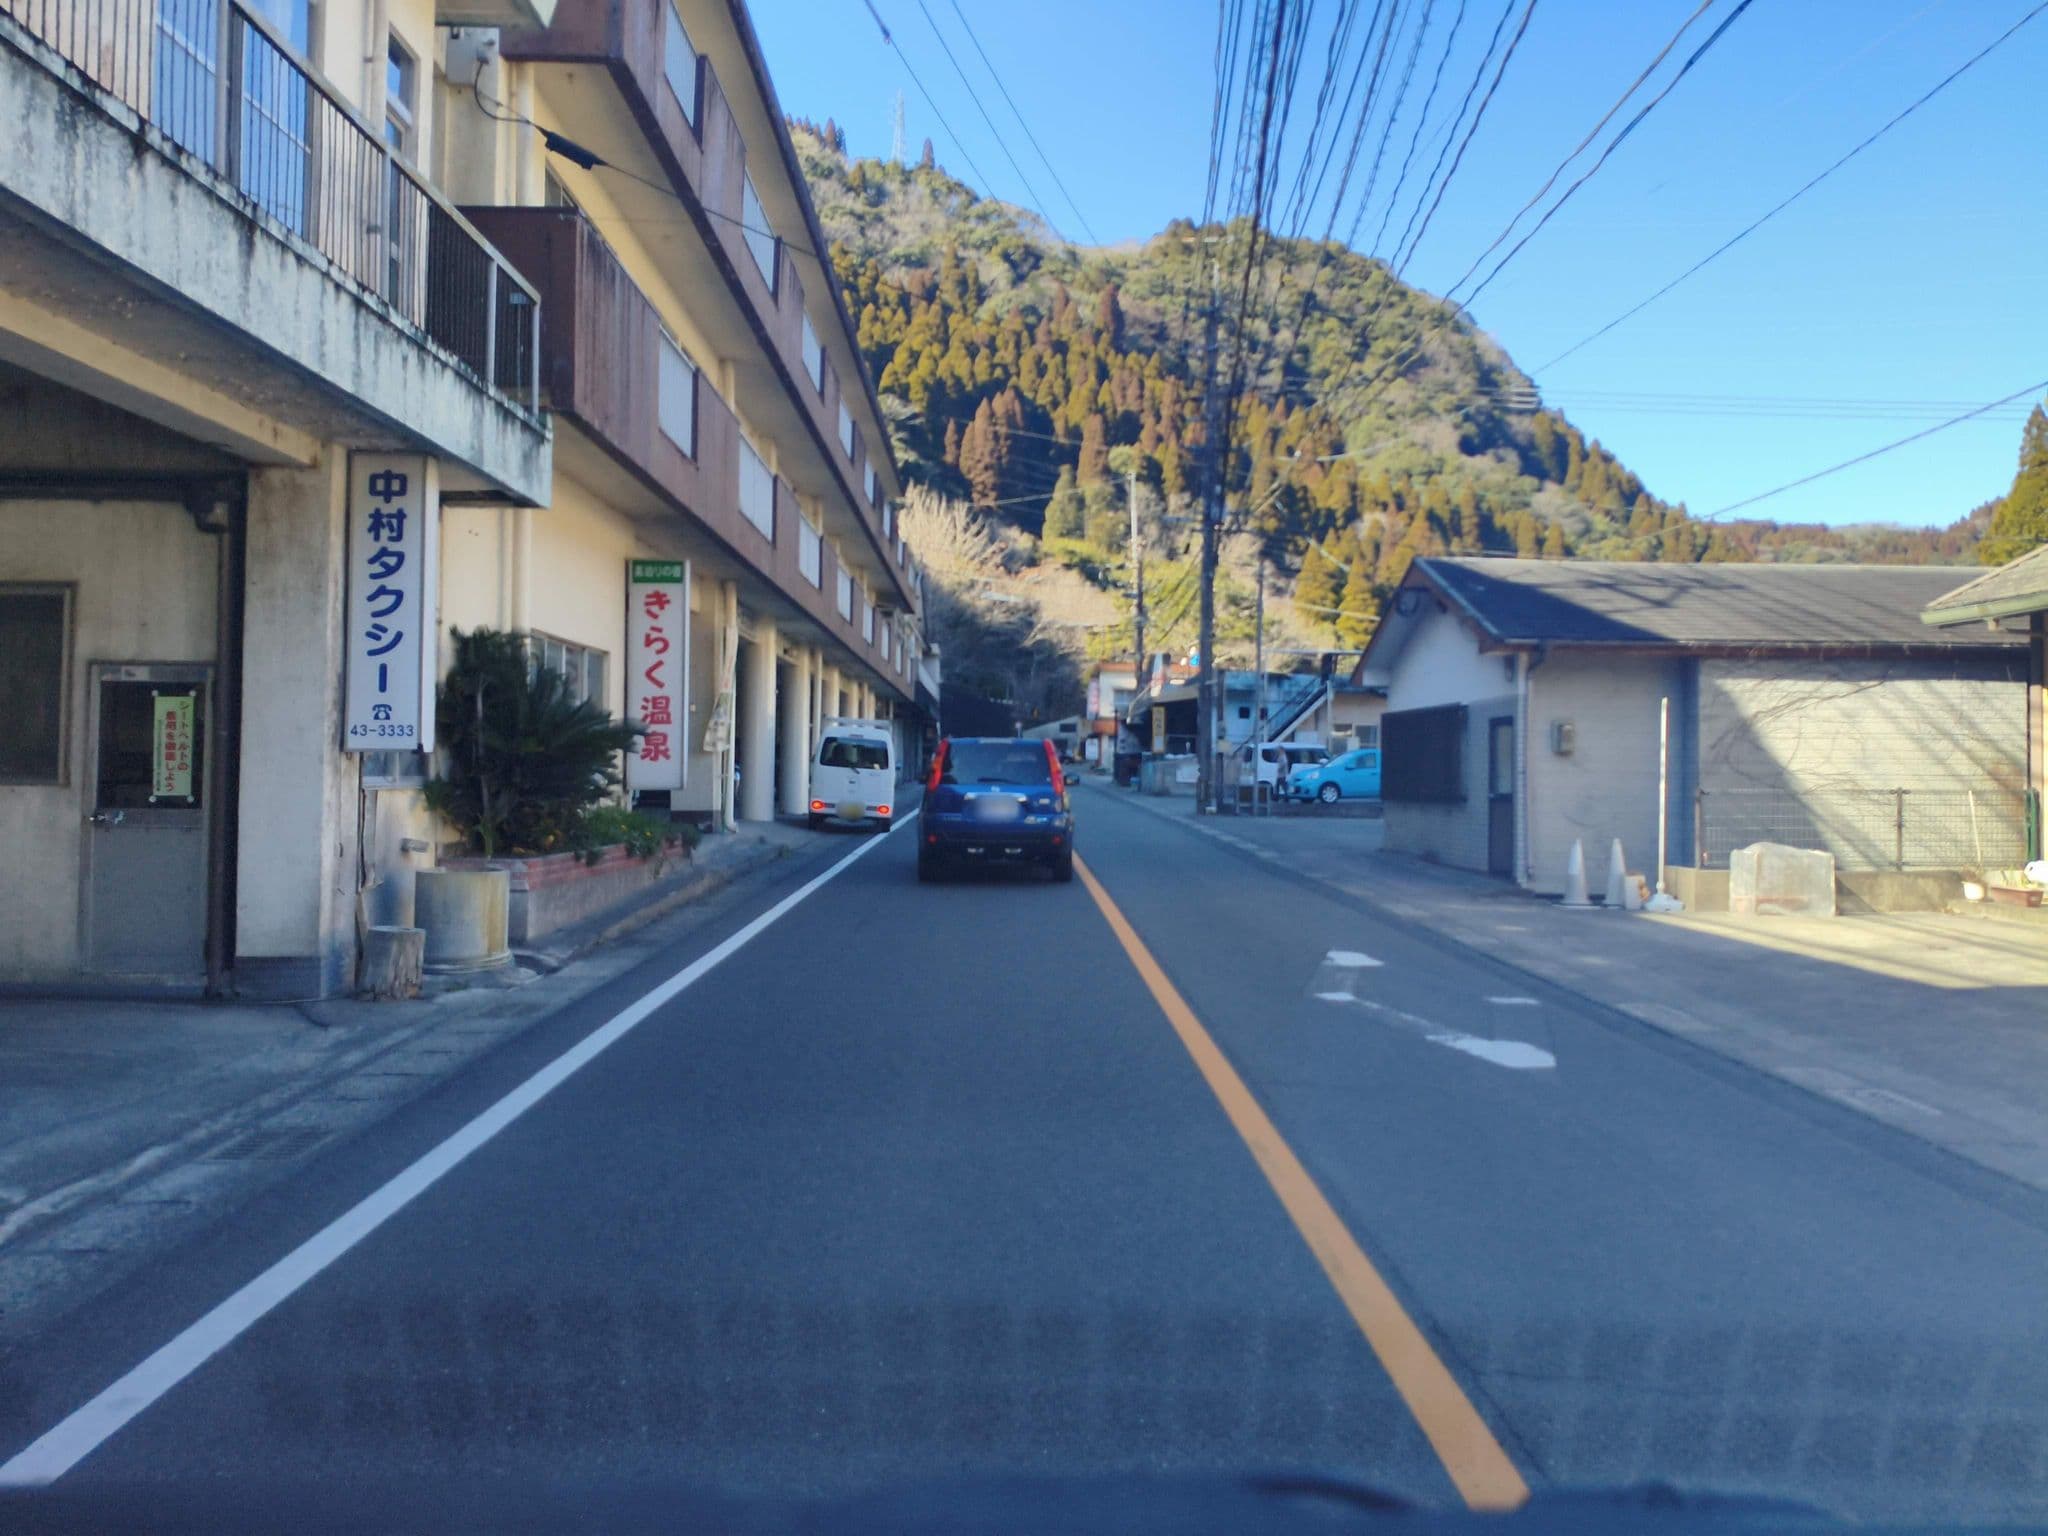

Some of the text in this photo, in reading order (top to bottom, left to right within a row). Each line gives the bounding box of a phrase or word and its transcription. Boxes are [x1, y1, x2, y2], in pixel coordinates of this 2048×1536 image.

[365, 469, 408, 693] 中村タクシー
[350, 724, 415, 737] 43-3333
[640, 590, 672, 762] きらく温泉
